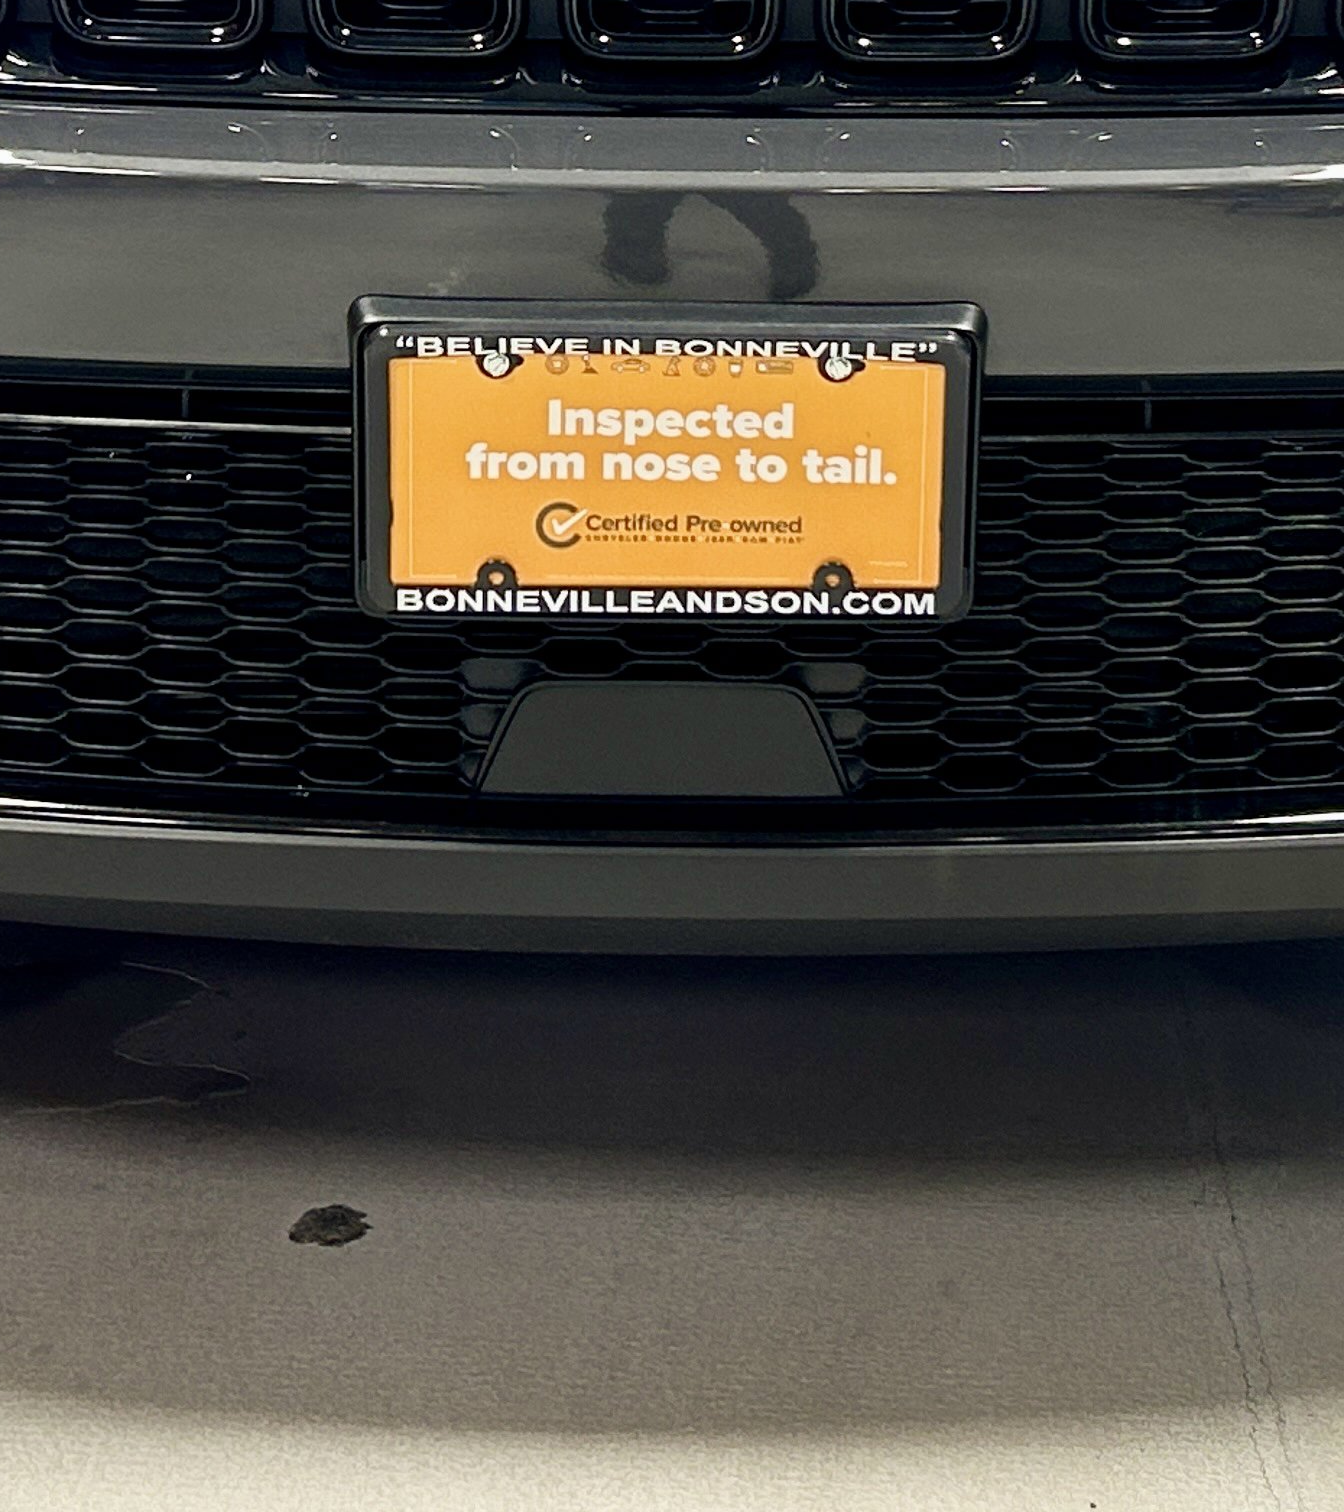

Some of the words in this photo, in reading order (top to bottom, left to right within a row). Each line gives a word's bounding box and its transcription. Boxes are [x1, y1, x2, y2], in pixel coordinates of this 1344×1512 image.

[602, 338, 639, 356] IN
[548, 399, 794, 444] Inspected
[466, 442, 586, 480] from
[603, 447, 722, 482] nose
[736, 449, 787, 483] to
[803, 444, 897, 485] tail.
[586, 513, 678, 533] Certified
[396, 588, 936, 616] BONNEVILLEANDSON.COM
